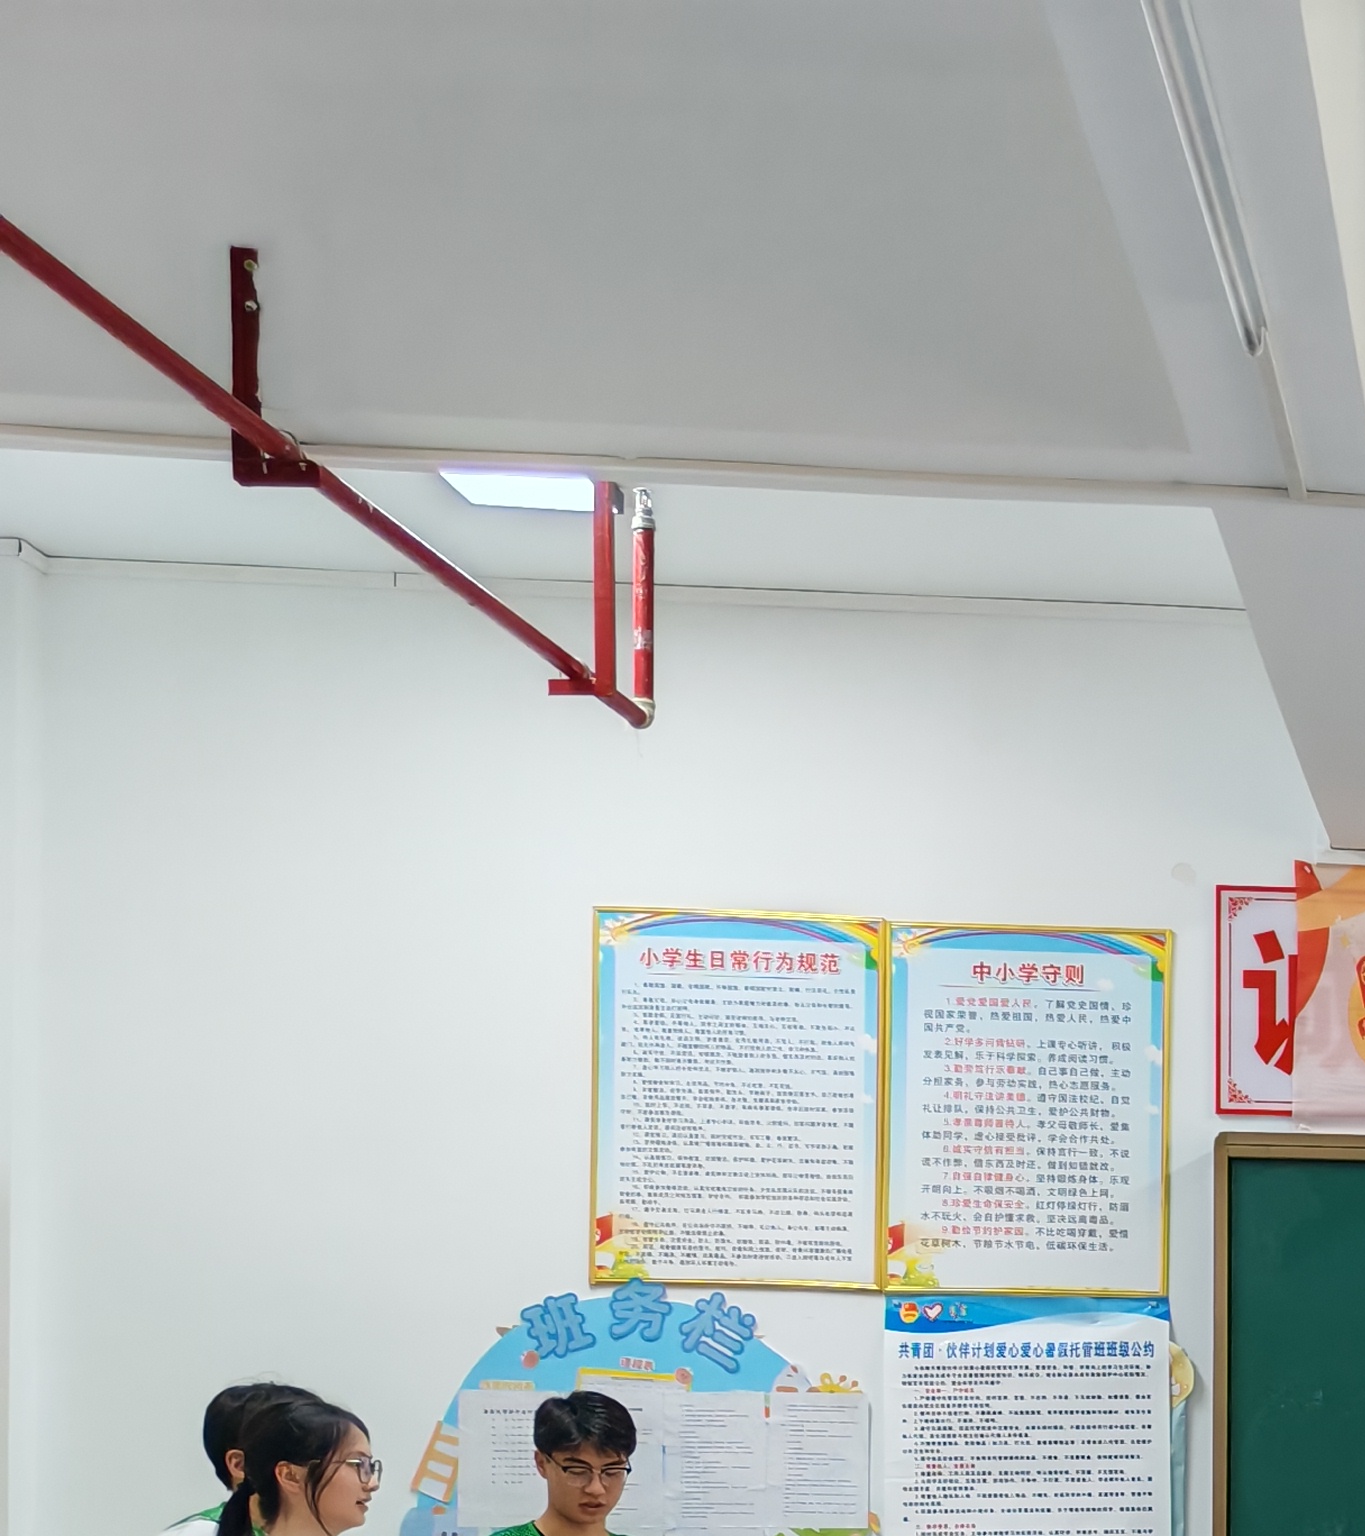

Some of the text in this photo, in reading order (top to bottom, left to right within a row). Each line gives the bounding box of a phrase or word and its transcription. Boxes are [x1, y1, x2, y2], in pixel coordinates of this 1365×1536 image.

[639, 947, 841, 974] 小学生日常行为规范
[971, 962, 1086, 986] 中小学守则
[520, 1278, 757, 1374] 班务栏
